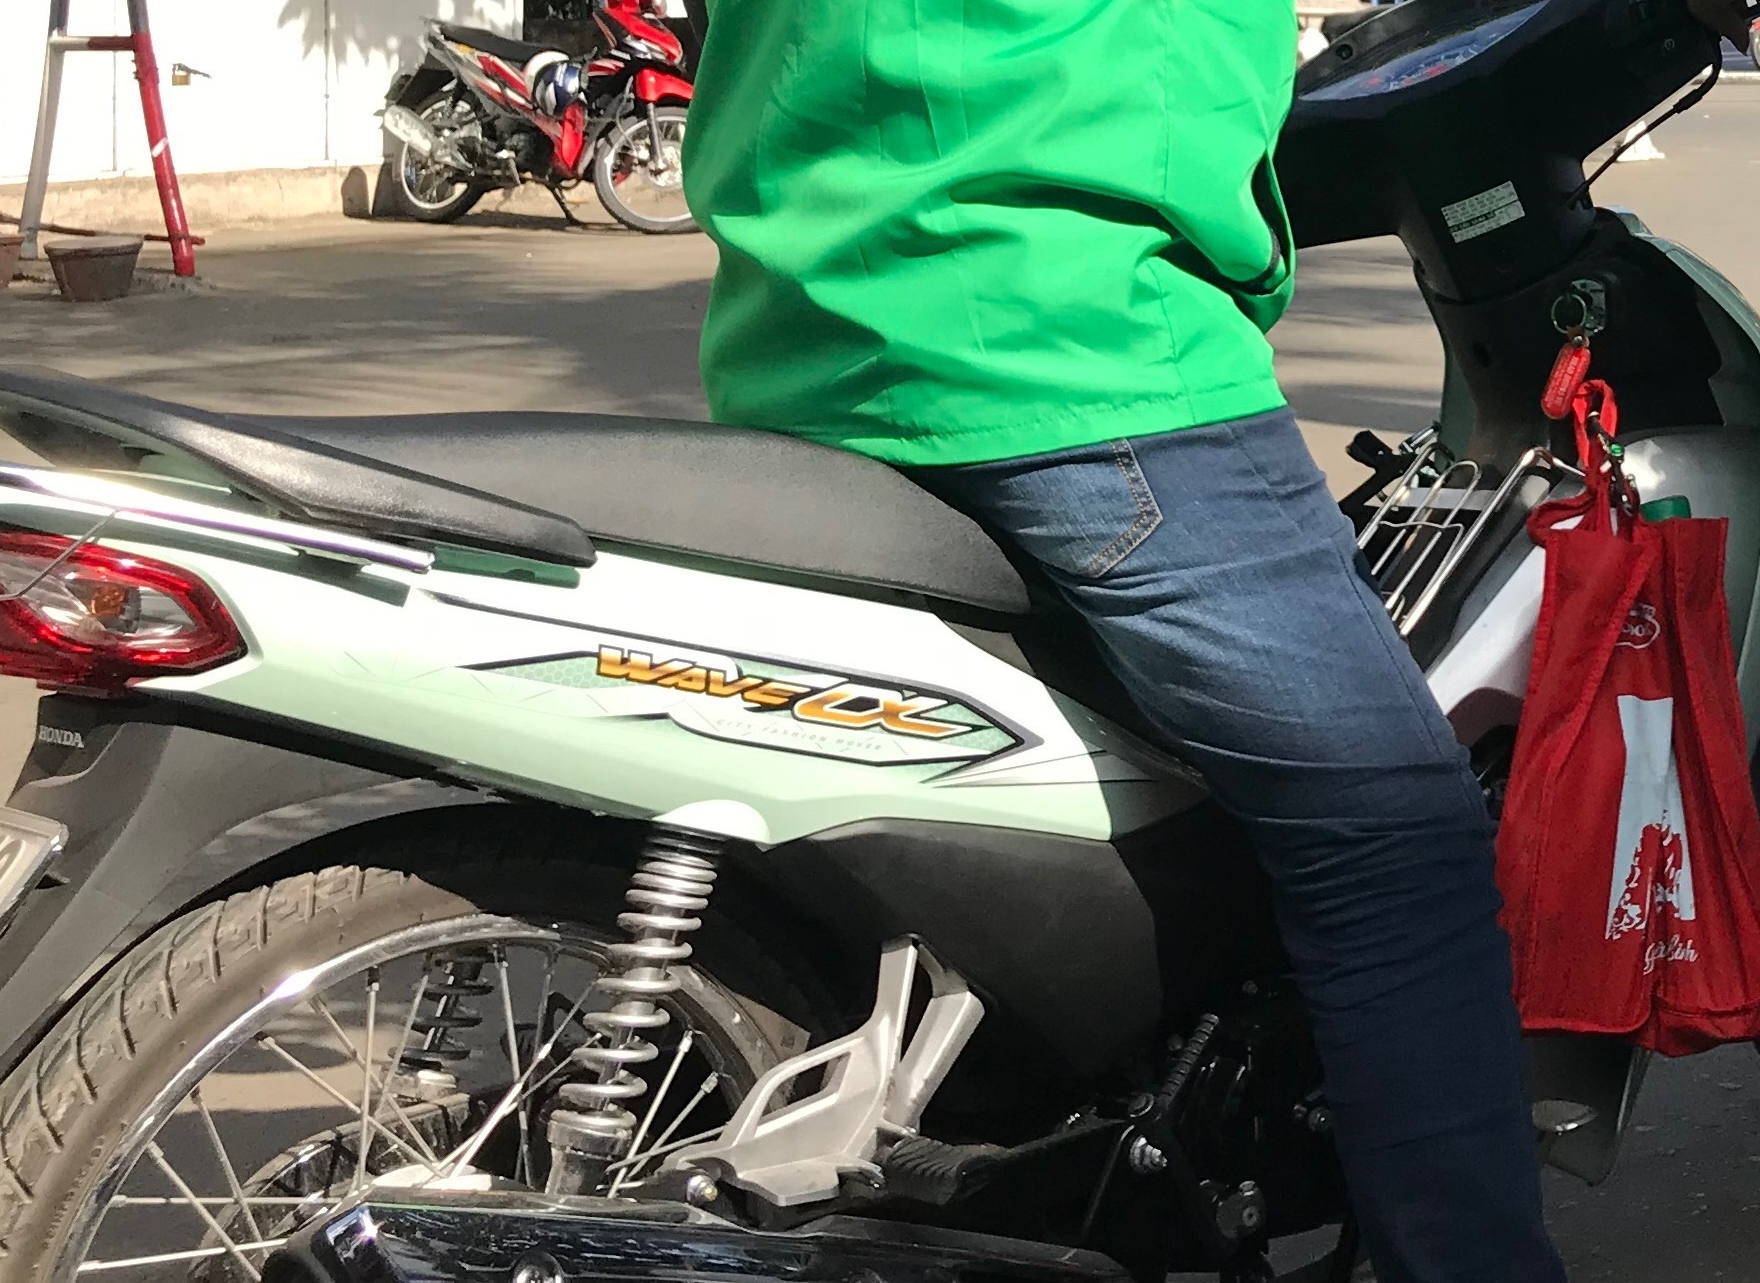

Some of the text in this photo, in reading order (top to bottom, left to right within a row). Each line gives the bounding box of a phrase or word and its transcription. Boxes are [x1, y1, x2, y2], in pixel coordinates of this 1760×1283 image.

[597, 644, 812, 706] WAVE
[39, 725, 84, 749] HONDA
[716, 719, 752, 729] CITY
[762, 726, 826, 742] FASHION
